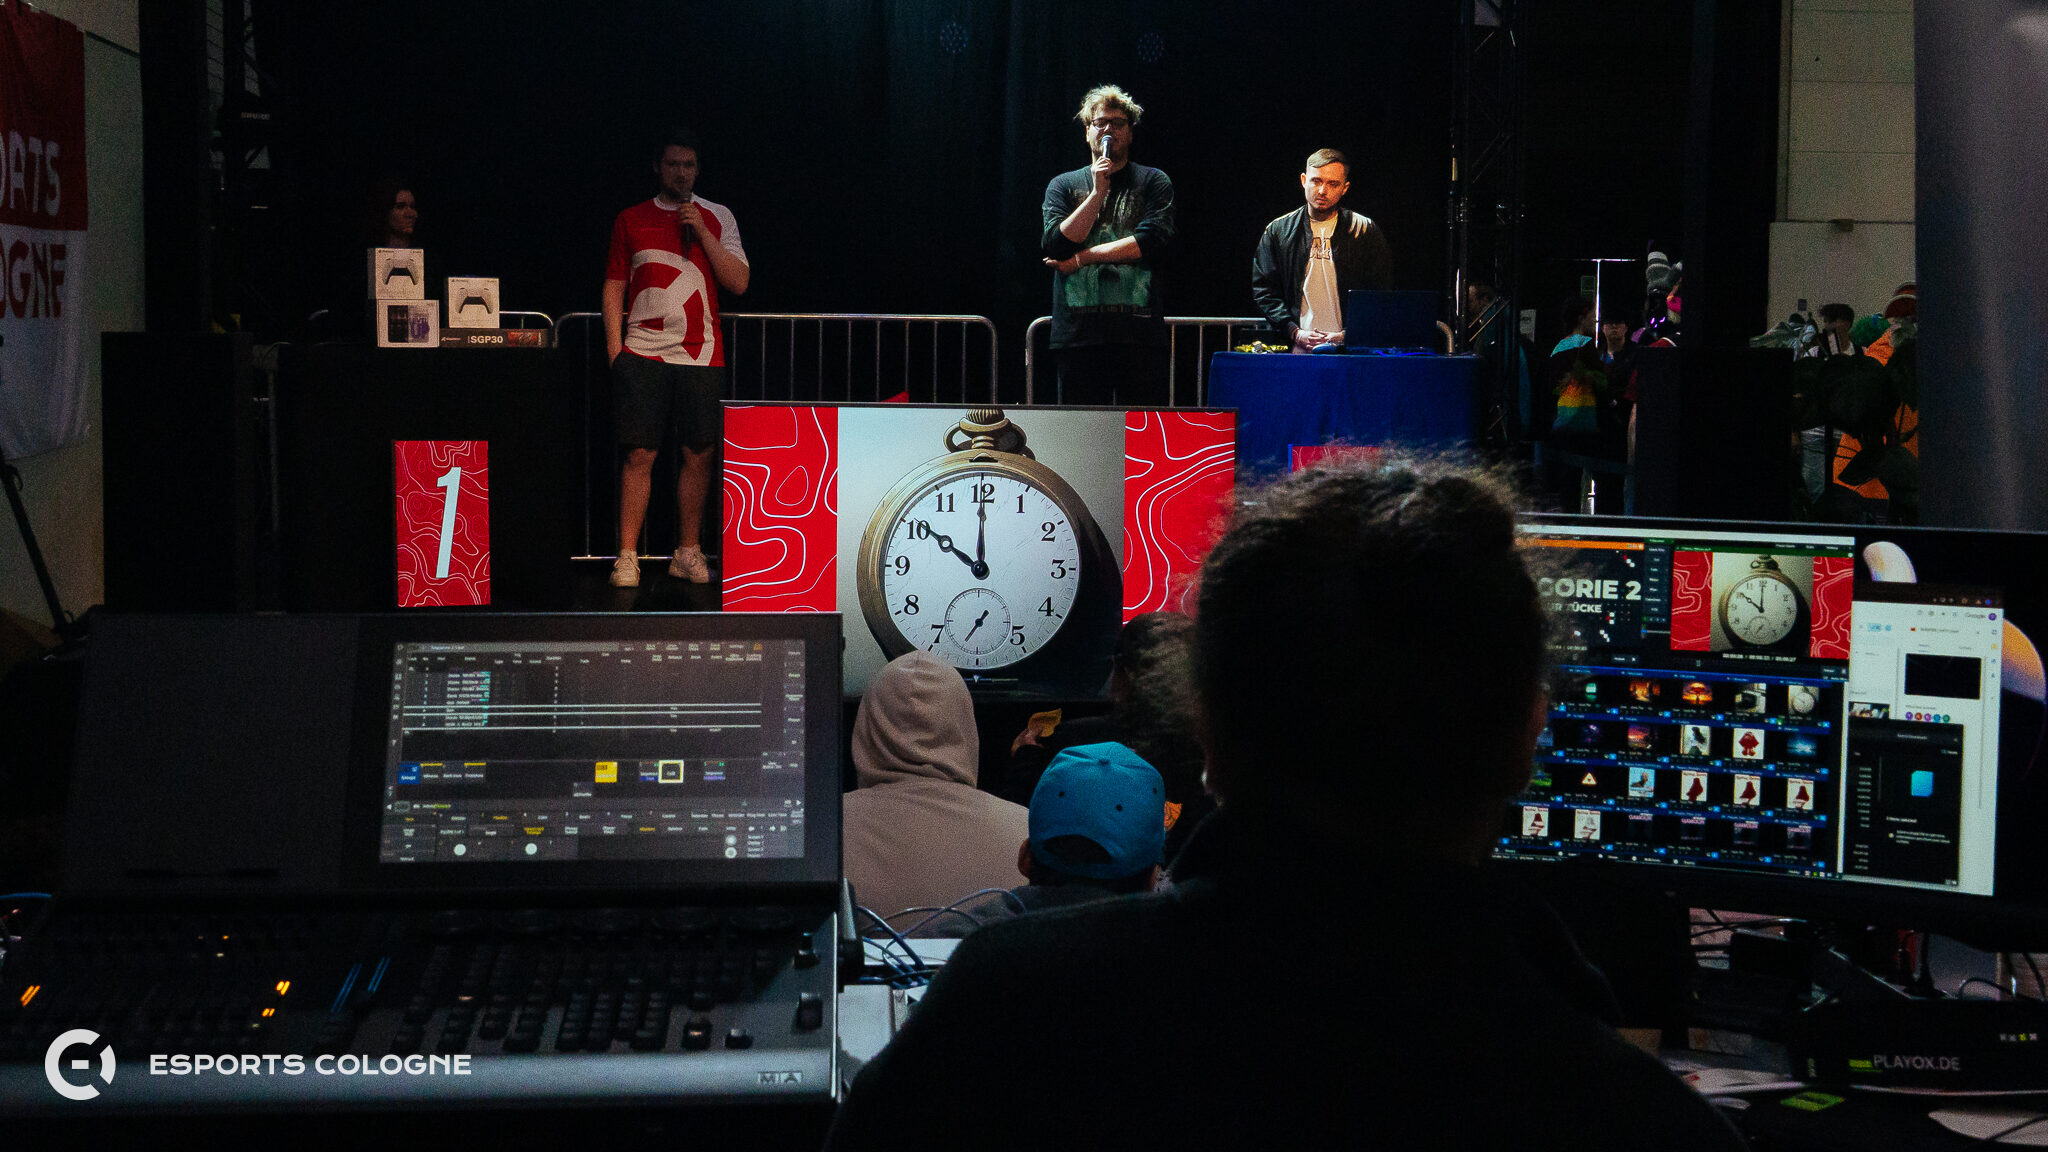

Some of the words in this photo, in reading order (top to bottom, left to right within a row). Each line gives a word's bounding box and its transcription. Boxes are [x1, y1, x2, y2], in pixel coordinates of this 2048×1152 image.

[470, 335, 504, 344] SGP30
[935, 492, 956, 513] 11
[971, 483, 995, 504] 12
[1016, 494, 1026, 513] 1
[436, 466, 462, 578] 1
[906, 520, 931, 540] 10
[1041, 522, 1056, 542] 2
[895, 555, 910, 576] 9
[1051, 559, 1066, 579] 3
[1625, 580, 1642, 600] 2
[903, 594, 920, 615] 8
[1038, 597, 1054, 617] 4
[931, 624, 945, 643] 7
[1009, 625, 1026, 645] 5
[1873, 1054, 1960, 1071] PLAYOX.DE
